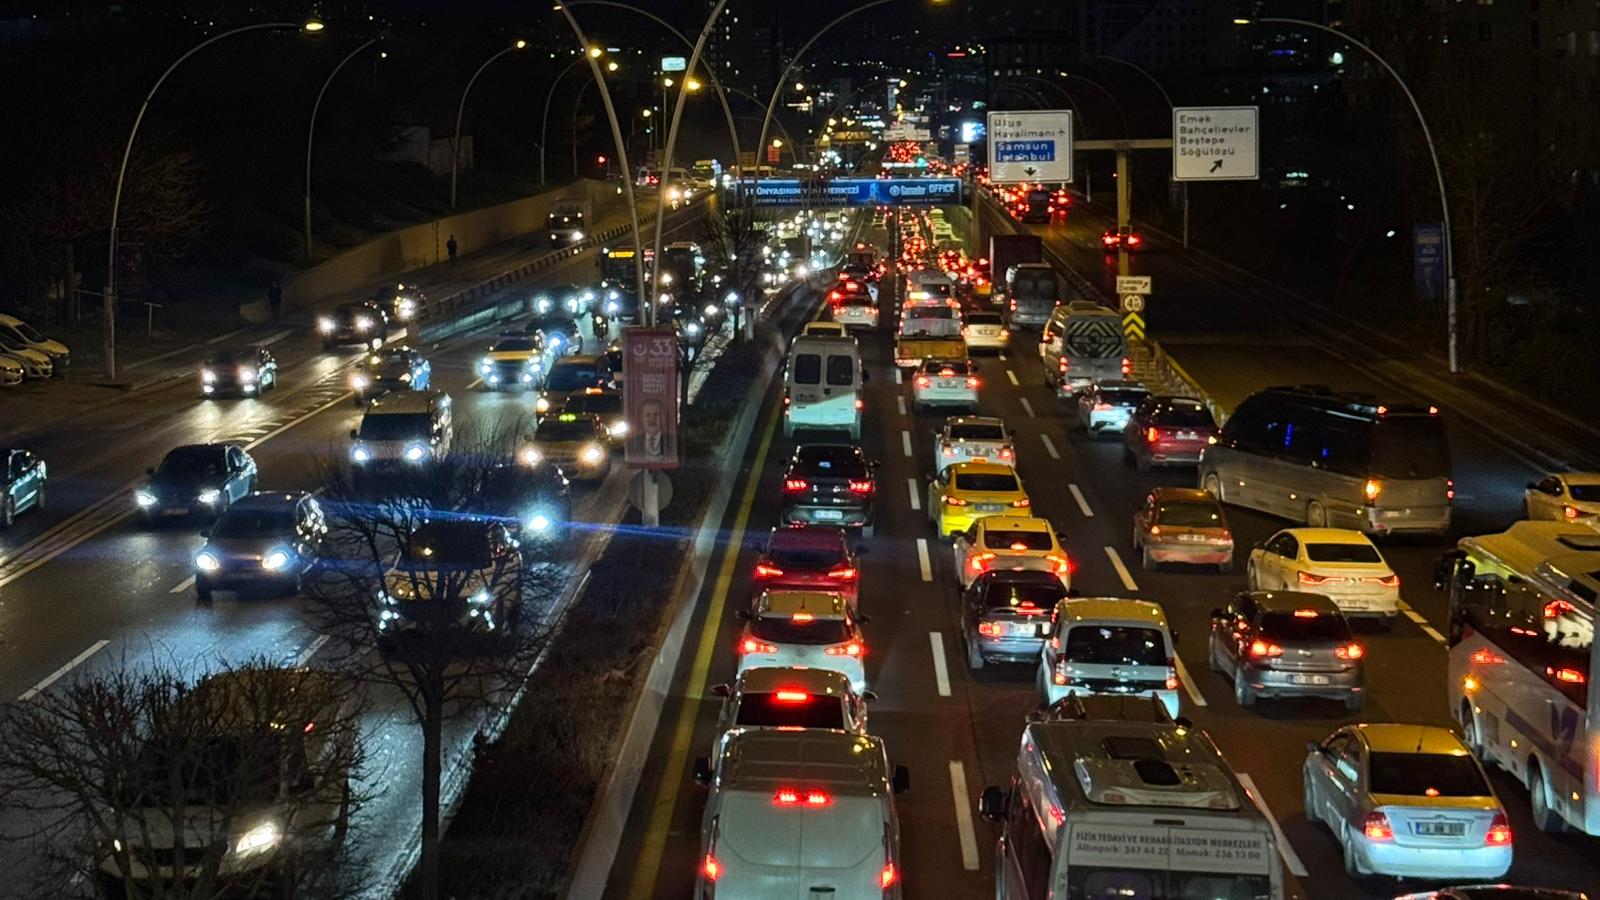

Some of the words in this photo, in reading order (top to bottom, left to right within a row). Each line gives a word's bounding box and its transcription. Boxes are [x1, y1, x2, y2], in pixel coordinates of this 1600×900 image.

[994, 118, 1022, 128] Ulus
[1180, 114, 1211, 124] Emek
[994, 129, 1055, 138] Havalimanı
[1180, 125, 1251, 134] Bahçelievler
[1180, 136, 1225, 145] Beştepe
[997, 142, 1048, 151] Samsun
[1180, 146, 1235, 157] Söğütözü
[997, 151, 1051, 161] İstanbul
[928, 183, 955, 193] OFFICE
[650, 338, 672, 356] 33
[1076, 831, 1096, 840] FİZİK
[1098, 832, 1127, 842] TEDAVİ
[1127, 833, 1138, 843] VE
[1209, 838, 1261, 849] MERKEZLERİ
